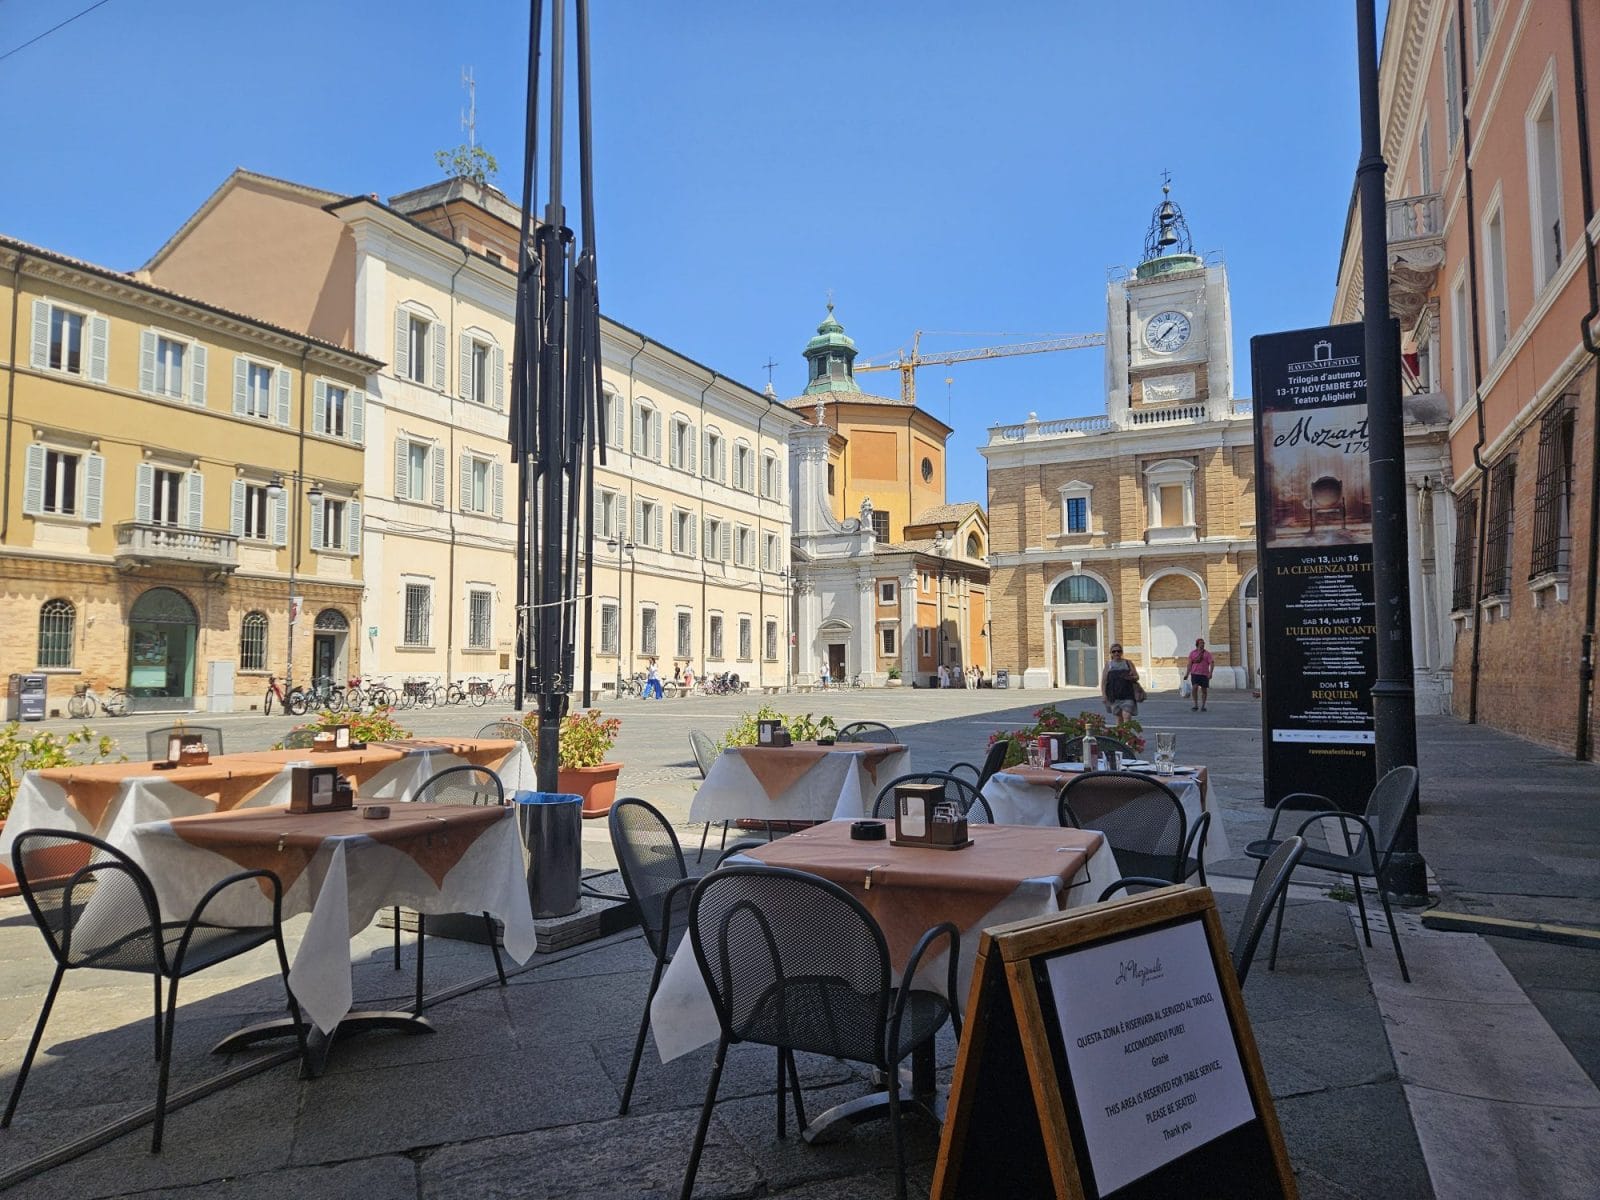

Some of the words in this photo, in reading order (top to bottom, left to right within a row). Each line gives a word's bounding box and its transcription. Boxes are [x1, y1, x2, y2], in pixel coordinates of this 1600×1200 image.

[1288, 375, 1319, 384] Trilogia
[1320, 371, 1360, 381] d'autunno
[1276, 386, 1299, 396] 13-17
[1301, 381, 1351, 394] NOVEMBRE
[1353, 379, 1368, 388] 202
[1294, 396, 1319, 405] Teatro
[1321, 391, 1356, 402] Alighieri
[1274, 416, 1369, 448] Mozart
[1344, 441, 1369, 453] 179
[1318, 556, 1330, 564] 13,
[1348, 554, 1359, 562] 16
[1276, 566, 1289, 575] LA
[1290, 564, 1345, 574] CLEMENZA
[1346, 563, 1358, 572] DI
[1319, 617, 1331, 625] 14,
[1351, 616, 1362, 624] 17
[1286, 626, 1332, 636] L'ULTIMO
[1339, 681, 1350, 689] 15
[1311, 690, 1358, 700] REQUIEM
[1077, 1031, 1102, 1049] QUESTA
[1101, 1024, 1121, 1040] ZONA
[1119, 1021, 1125, 1033] È
[1125, 1013, 1155, 1032] RISERVATA
[1154, 1010, 1162, 1020] AL
[1161, 1002, 1186, 1018] SERVIZIO
[1185, 1000, 1193, 1009] AL
[1124, 1030, 1169, 1055] ACCOMODATEVI
[1169, 1024, 1186, 1039] PURE!
[1151, 1052, 1170, 1067] Grazie
[1104, 1102, 1120, 1117] THIS
[1120, 1096, 1138, 1111] AREA
[1136, 1092, 1144, 1104] IS
[1143, 1080, 1172, 1102] RESERVED
[1171, 1075, 1184, 1088] FOR
[1183, 1068, 1200, 1083] TABLE
[1145, 1105, 1168, 1124] PLEASE
[1166, 1102, 1176, 1115] BE
[1174, 1092, 1198, 1111] SEATED!
[1163, 1124, 1181, 1141] Thank
[1180, 1121, 1193, 1135] you
